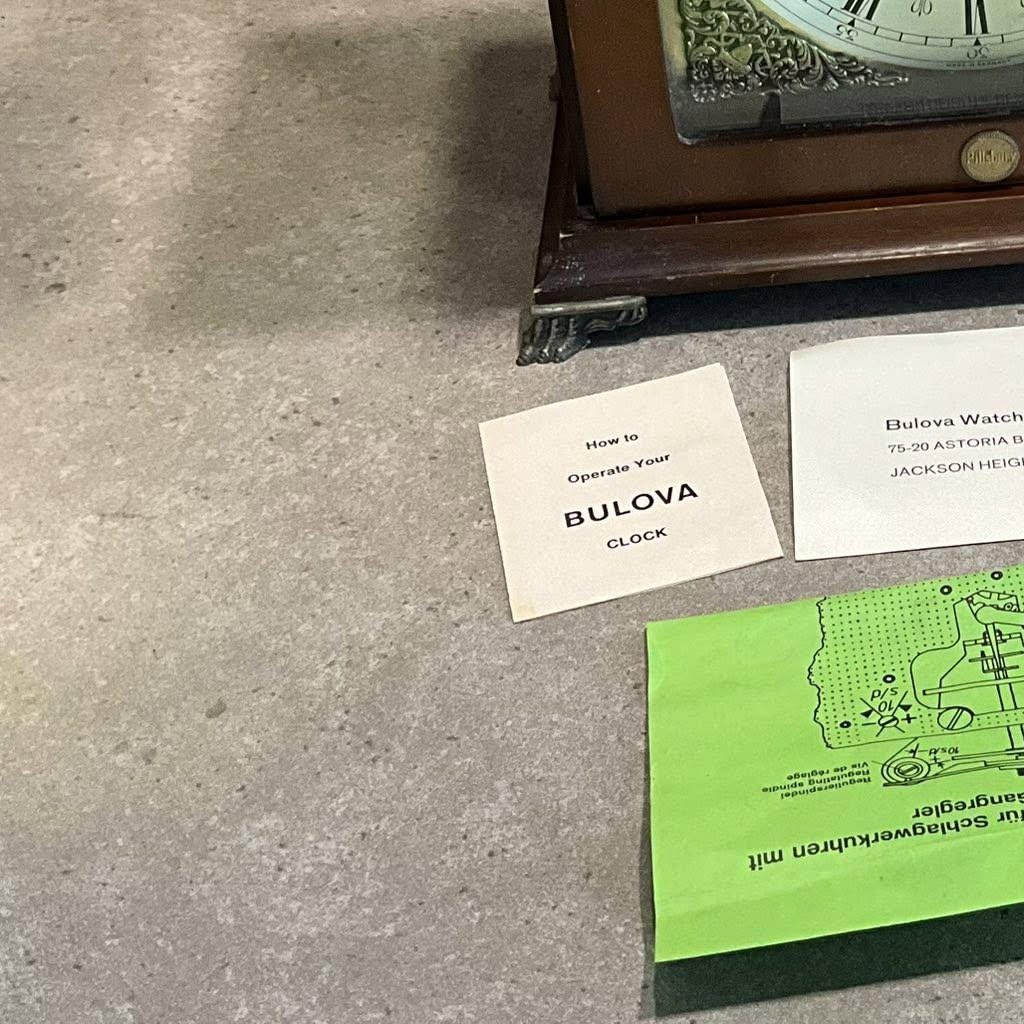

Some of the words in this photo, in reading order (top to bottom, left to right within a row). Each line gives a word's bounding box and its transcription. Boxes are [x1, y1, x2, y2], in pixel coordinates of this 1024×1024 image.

[836, 24, 860, 42] 35
[885, 414, 955, 431] Bulova
[960, 409, 1024, 426] Watch
[586, 437, 620, 450] How
[624, 433, 639, 443] to
[888, 440, 930, 454] 75-20
[933, 435, 1009, 451] ASTORIA
[567, 464, 630, 484] Operate
[634, 453, 671, 468] Your
[890, 461, 975, 477] JACKSON
[564, 483, 699, 528] BULOVA
[606, 527, 668, 549] CLOCK
[878, 700, 895, 713] 10
[833, 765, 847, 773] de
[851, 761, 869, 769] Vis
[808, 769, 870, 786] Regulating
[792, 814, 989, 859] Schlagwerkuhren
[748, 848, 784, 871] mit
